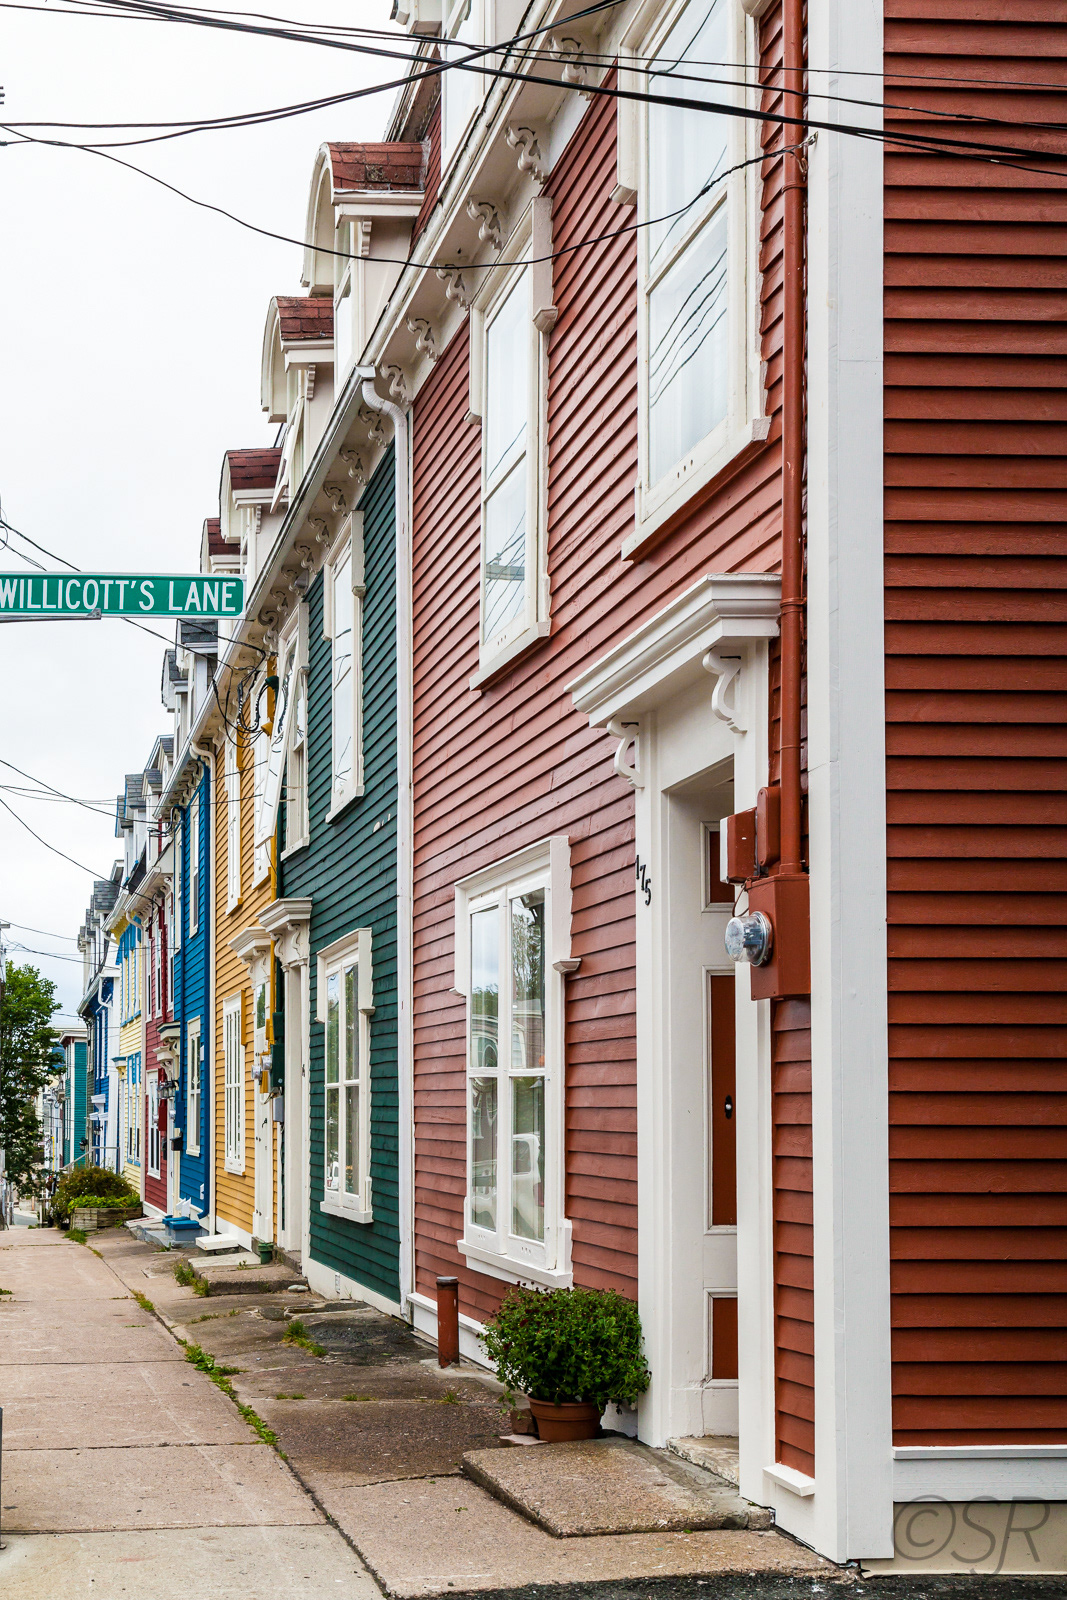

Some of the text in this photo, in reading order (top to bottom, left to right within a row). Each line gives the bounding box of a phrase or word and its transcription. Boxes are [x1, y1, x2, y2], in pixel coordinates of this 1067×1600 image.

[0, 578, 237, 612] WILLICOTT'S LANE
[635, 854, 652, 906] 175
